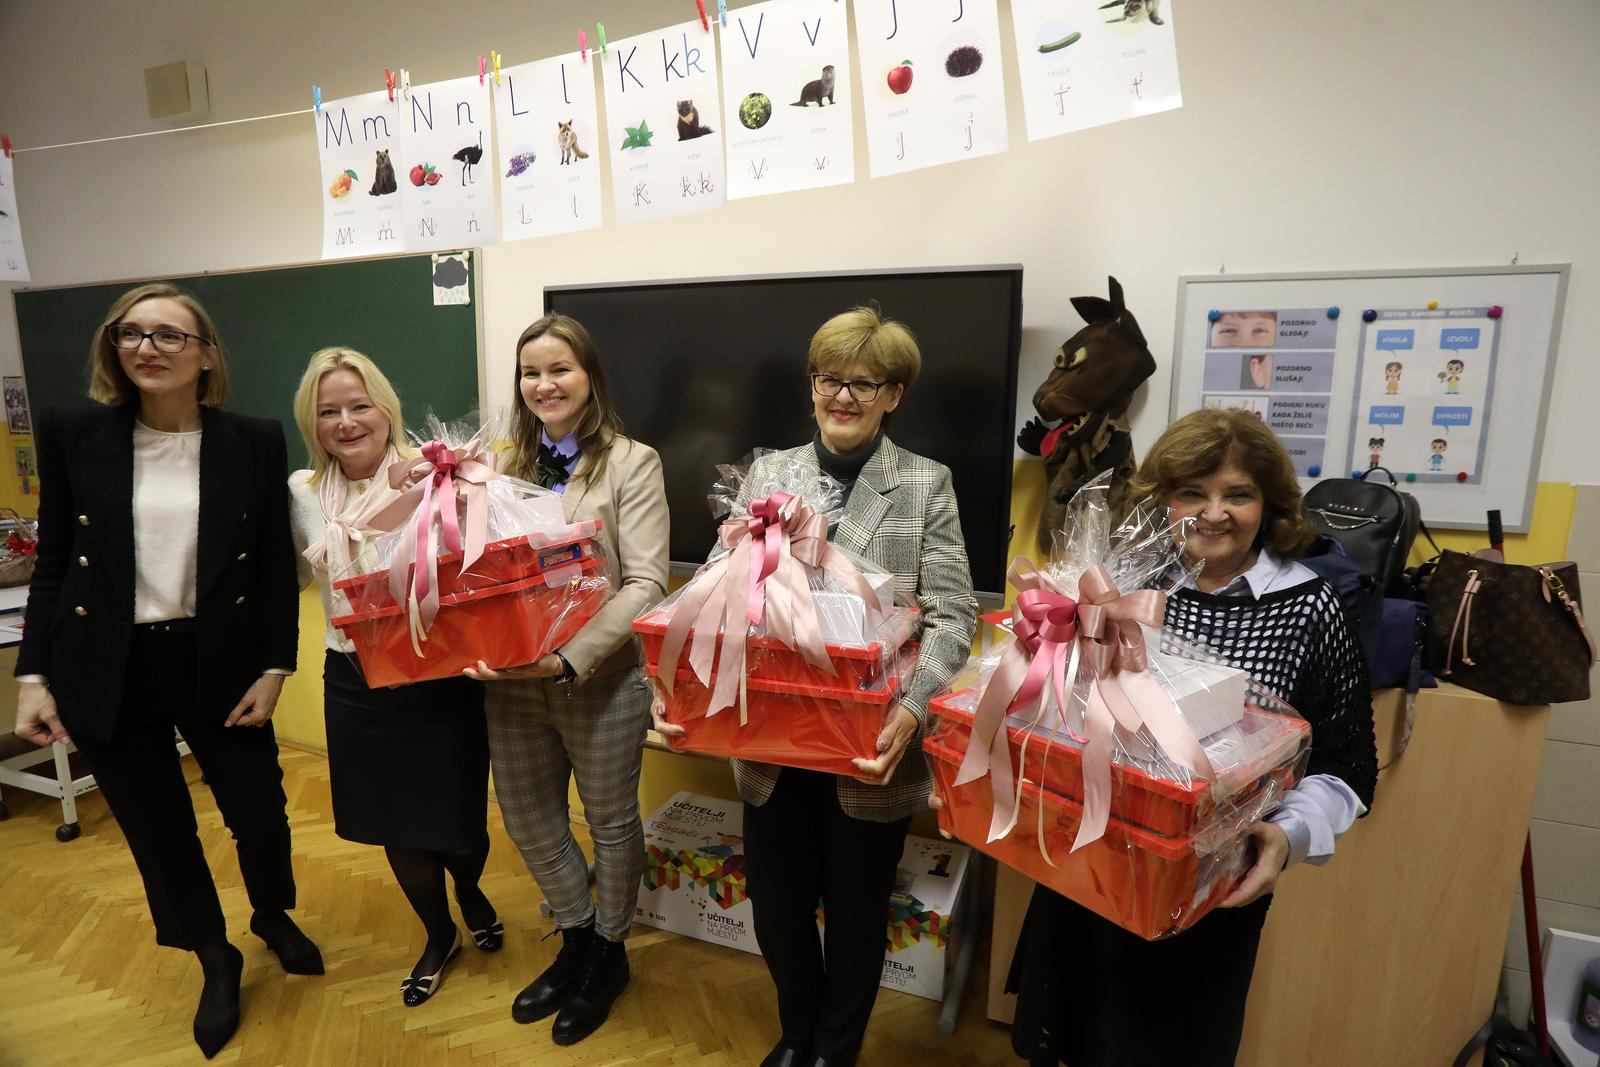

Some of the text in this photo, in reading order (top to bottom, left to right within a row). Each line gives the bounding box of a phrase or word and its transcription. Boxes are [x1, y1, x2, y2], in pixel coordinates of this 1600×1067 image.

[738, 12, 764, 59] V
[617, 46, 644, 92] K
[508, 75, 529, 116] L
[411, 92, 475, 133] N n
[325, 107, 391, 148] M m
[1280, 319, 1317, 327] POZORNO
[1382, 335, 1408, 344] HVALA
[1446, 335, 1473, 343] IZVOLI
[673, 801, 727, 818] UČITELJI
[707, 912, 744, 928] UČITELJI
[707, 920, 747, 936] NA PRVOM
[706, 927, 739, 942] MJESTU
[884, 959, 914, 973] ITELJI
[885, 967, 917, 981] PRVOM
